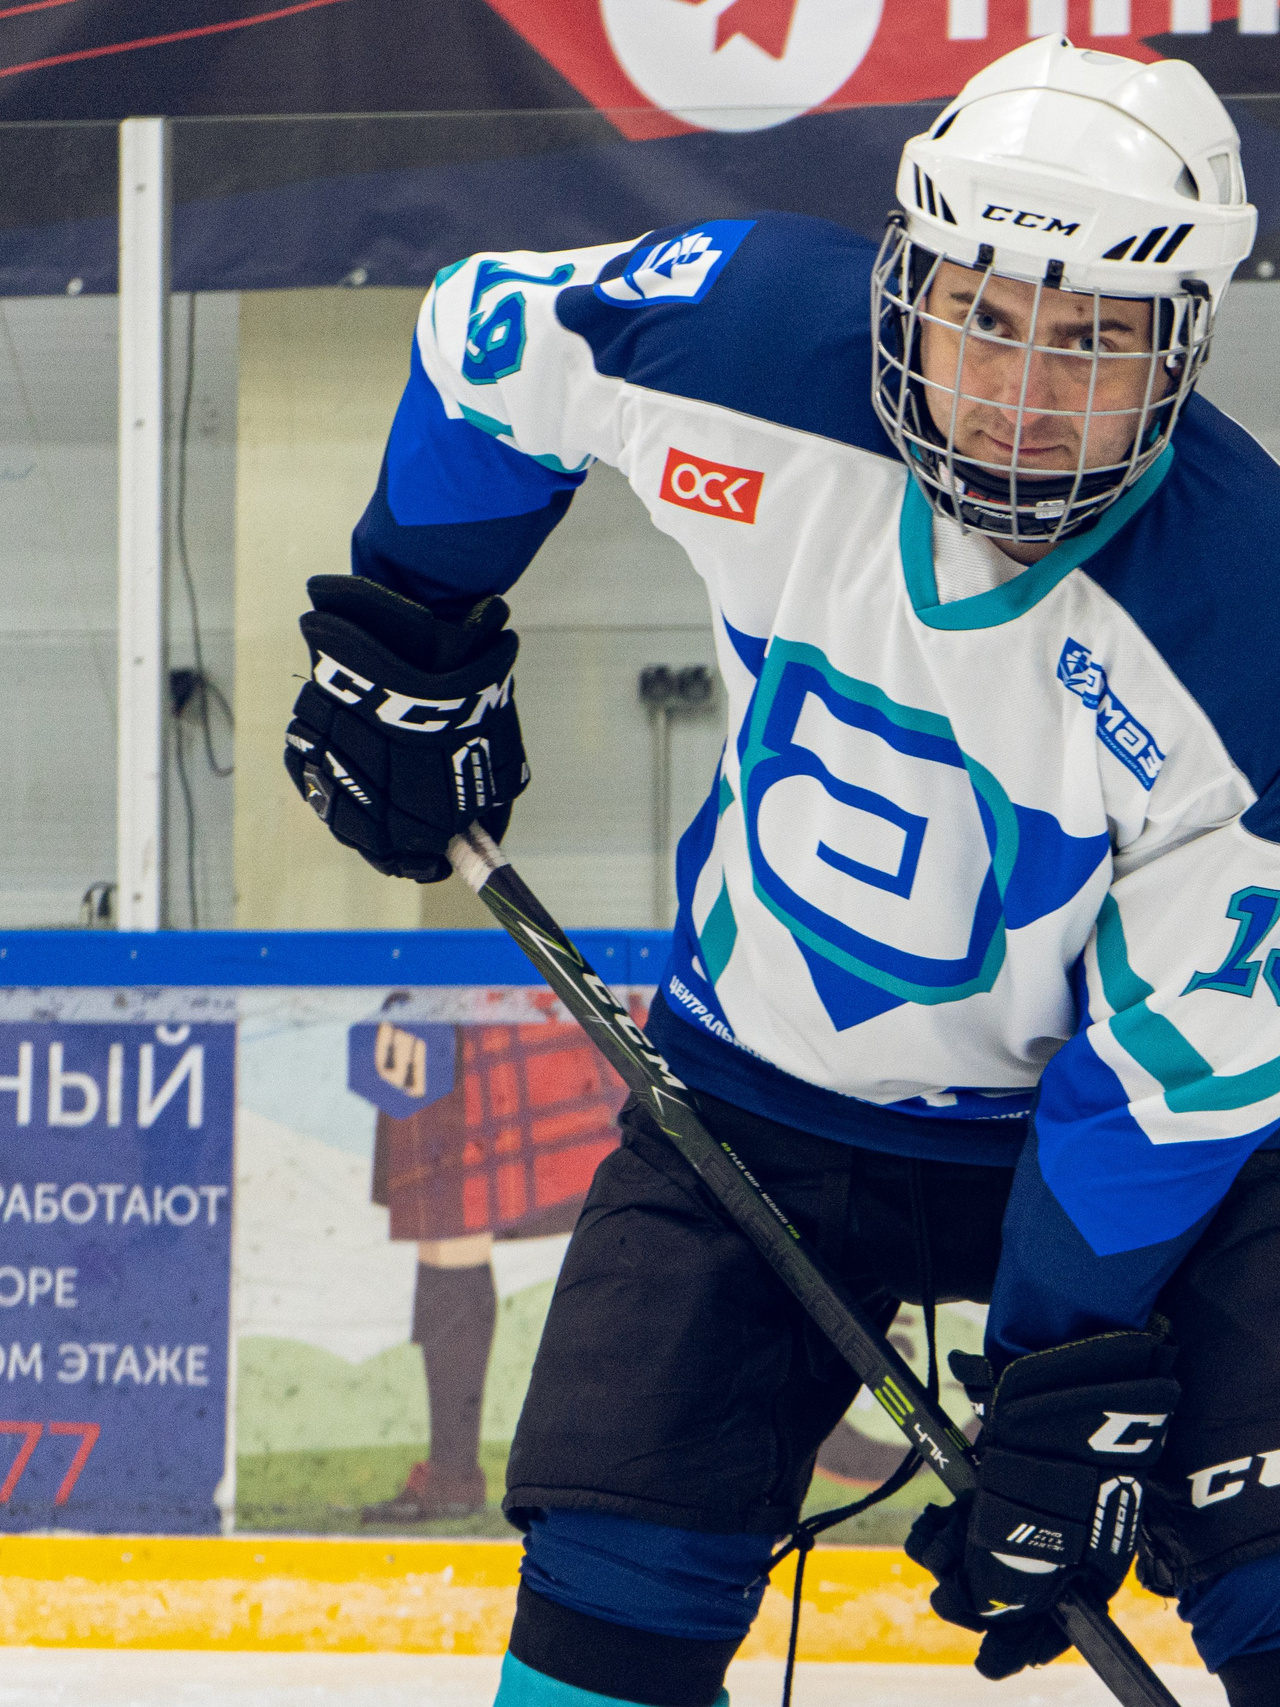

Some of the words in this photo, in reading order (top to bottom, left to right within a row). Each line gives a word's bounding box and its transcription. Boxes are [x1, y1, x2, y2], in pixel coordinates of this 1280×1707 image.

[981, 203, 1081, 236] CCM
[461, 259, 576, 386] 19
[671, 462, 751, 513] ОСК
[313, 650, 514, 733] CCM
[582, 973, 689, 1090] CCM
[0, 1183, 228, 1227] АБОТАЮТ
[57, 1342, 210, 1387] ЭТАЖЕ
[913, 1422, 950, 1470] 47K
